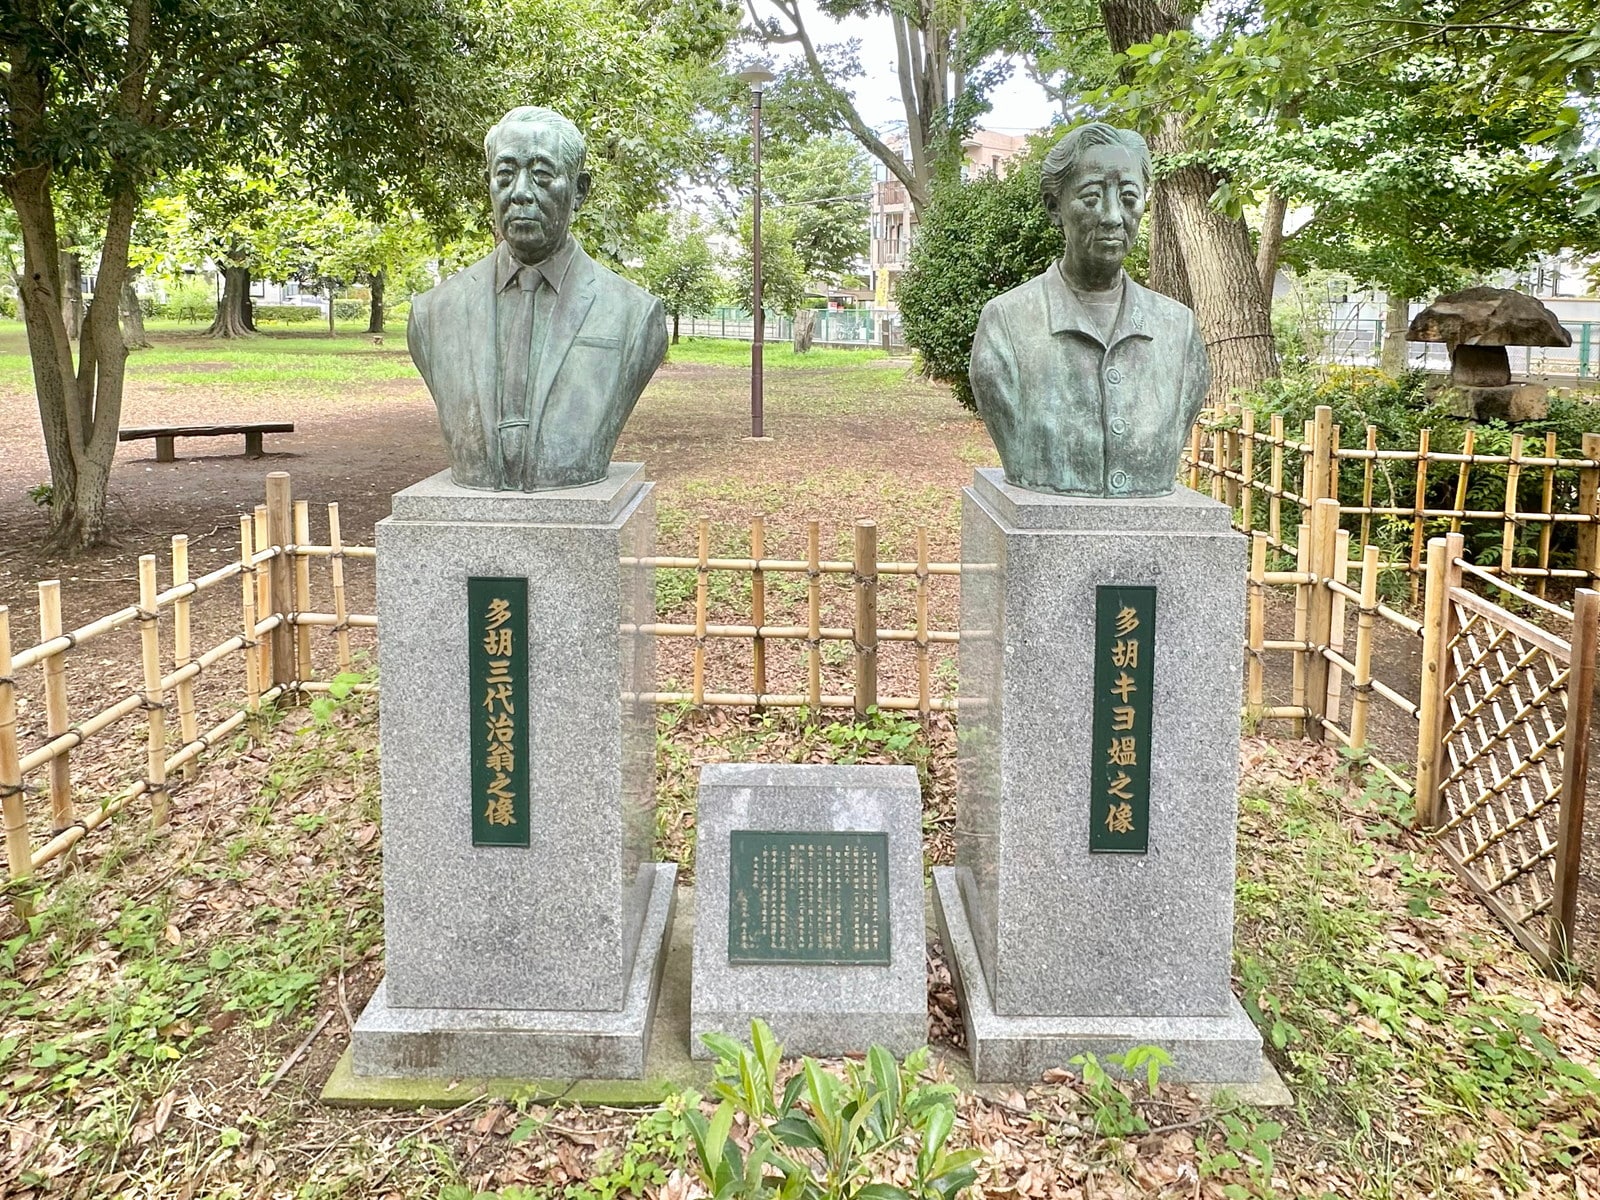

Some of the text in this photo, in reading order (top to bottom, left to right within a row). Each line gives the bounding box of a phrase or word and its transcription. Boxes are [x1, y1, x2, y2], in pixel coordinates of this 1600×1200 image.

[483, 598, 516, 825] 多胡三代治翁之像
